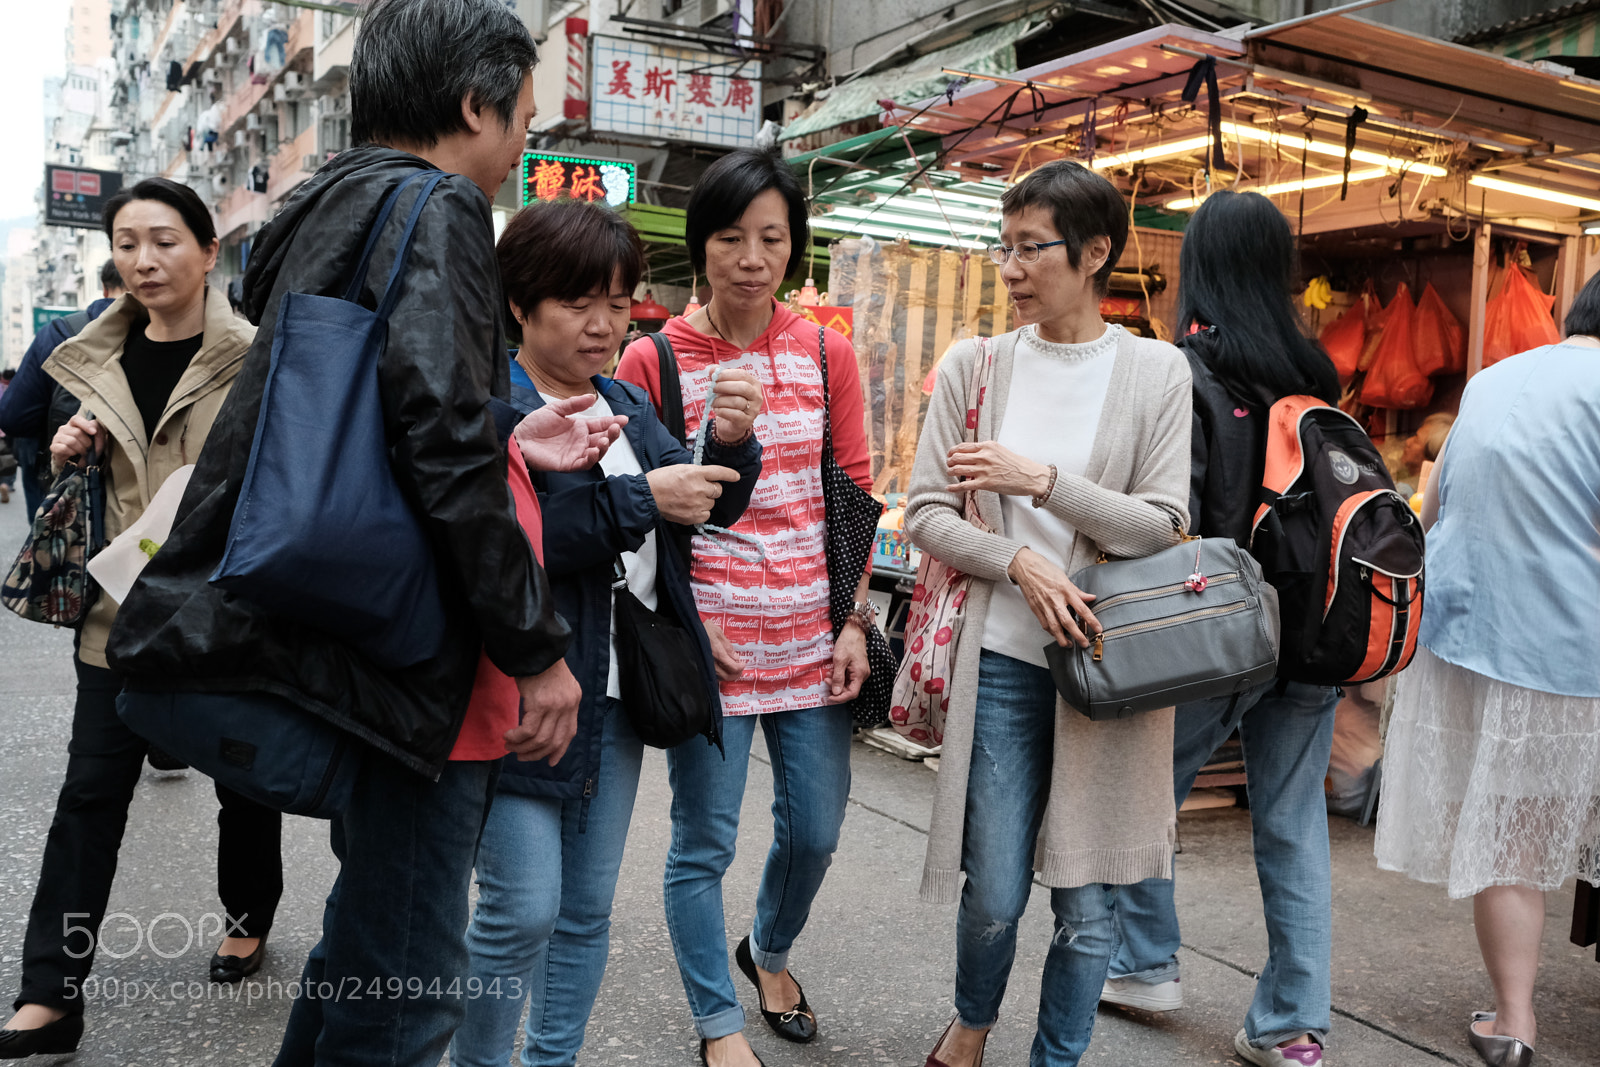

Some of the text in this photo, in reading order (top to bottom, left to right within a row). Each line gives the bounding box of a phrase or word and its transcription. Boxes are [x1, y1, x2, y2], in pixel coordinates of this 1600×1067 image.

[777, 420, 802, 429] Tomato
[754, 484, 779, 495] Tomato
[697, 588, 722, 599] Tomato
[732, 593, 759, 602] Tomato
[768, 595, 793, 603] Tomato
[764, 650, 788, 658] Tomato
[758, 697, 783, 706] Tomato
[792, 693, 819, 702] Tomato
